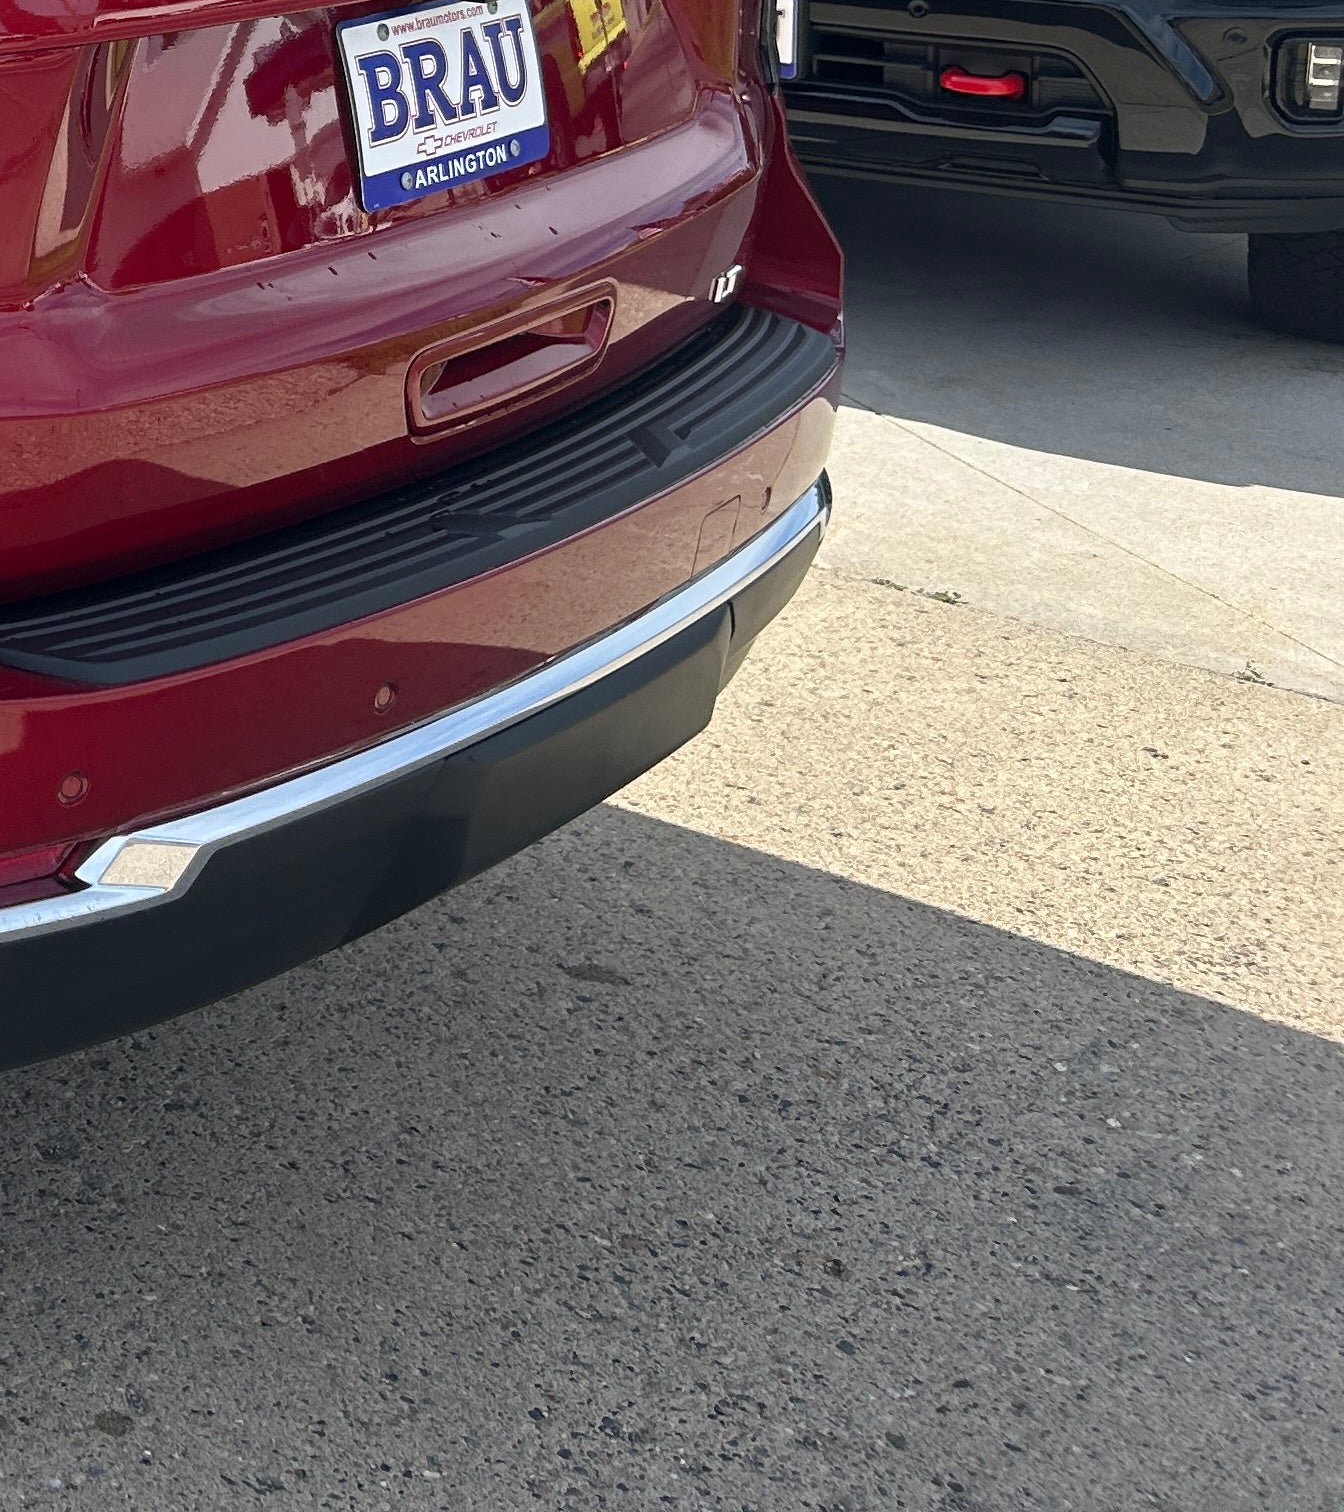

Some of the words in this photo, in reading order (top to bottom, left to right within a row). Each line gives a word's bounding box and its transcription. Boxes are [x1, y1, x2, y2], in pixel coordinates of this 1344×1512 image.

[391, 4, 484, 36] www.braumotors.com
[354, 13, 528, 148] BRAU
[442, 121, 498, 147] CHEVROLET
[415, 143, 507, 189] ARLINGTON
